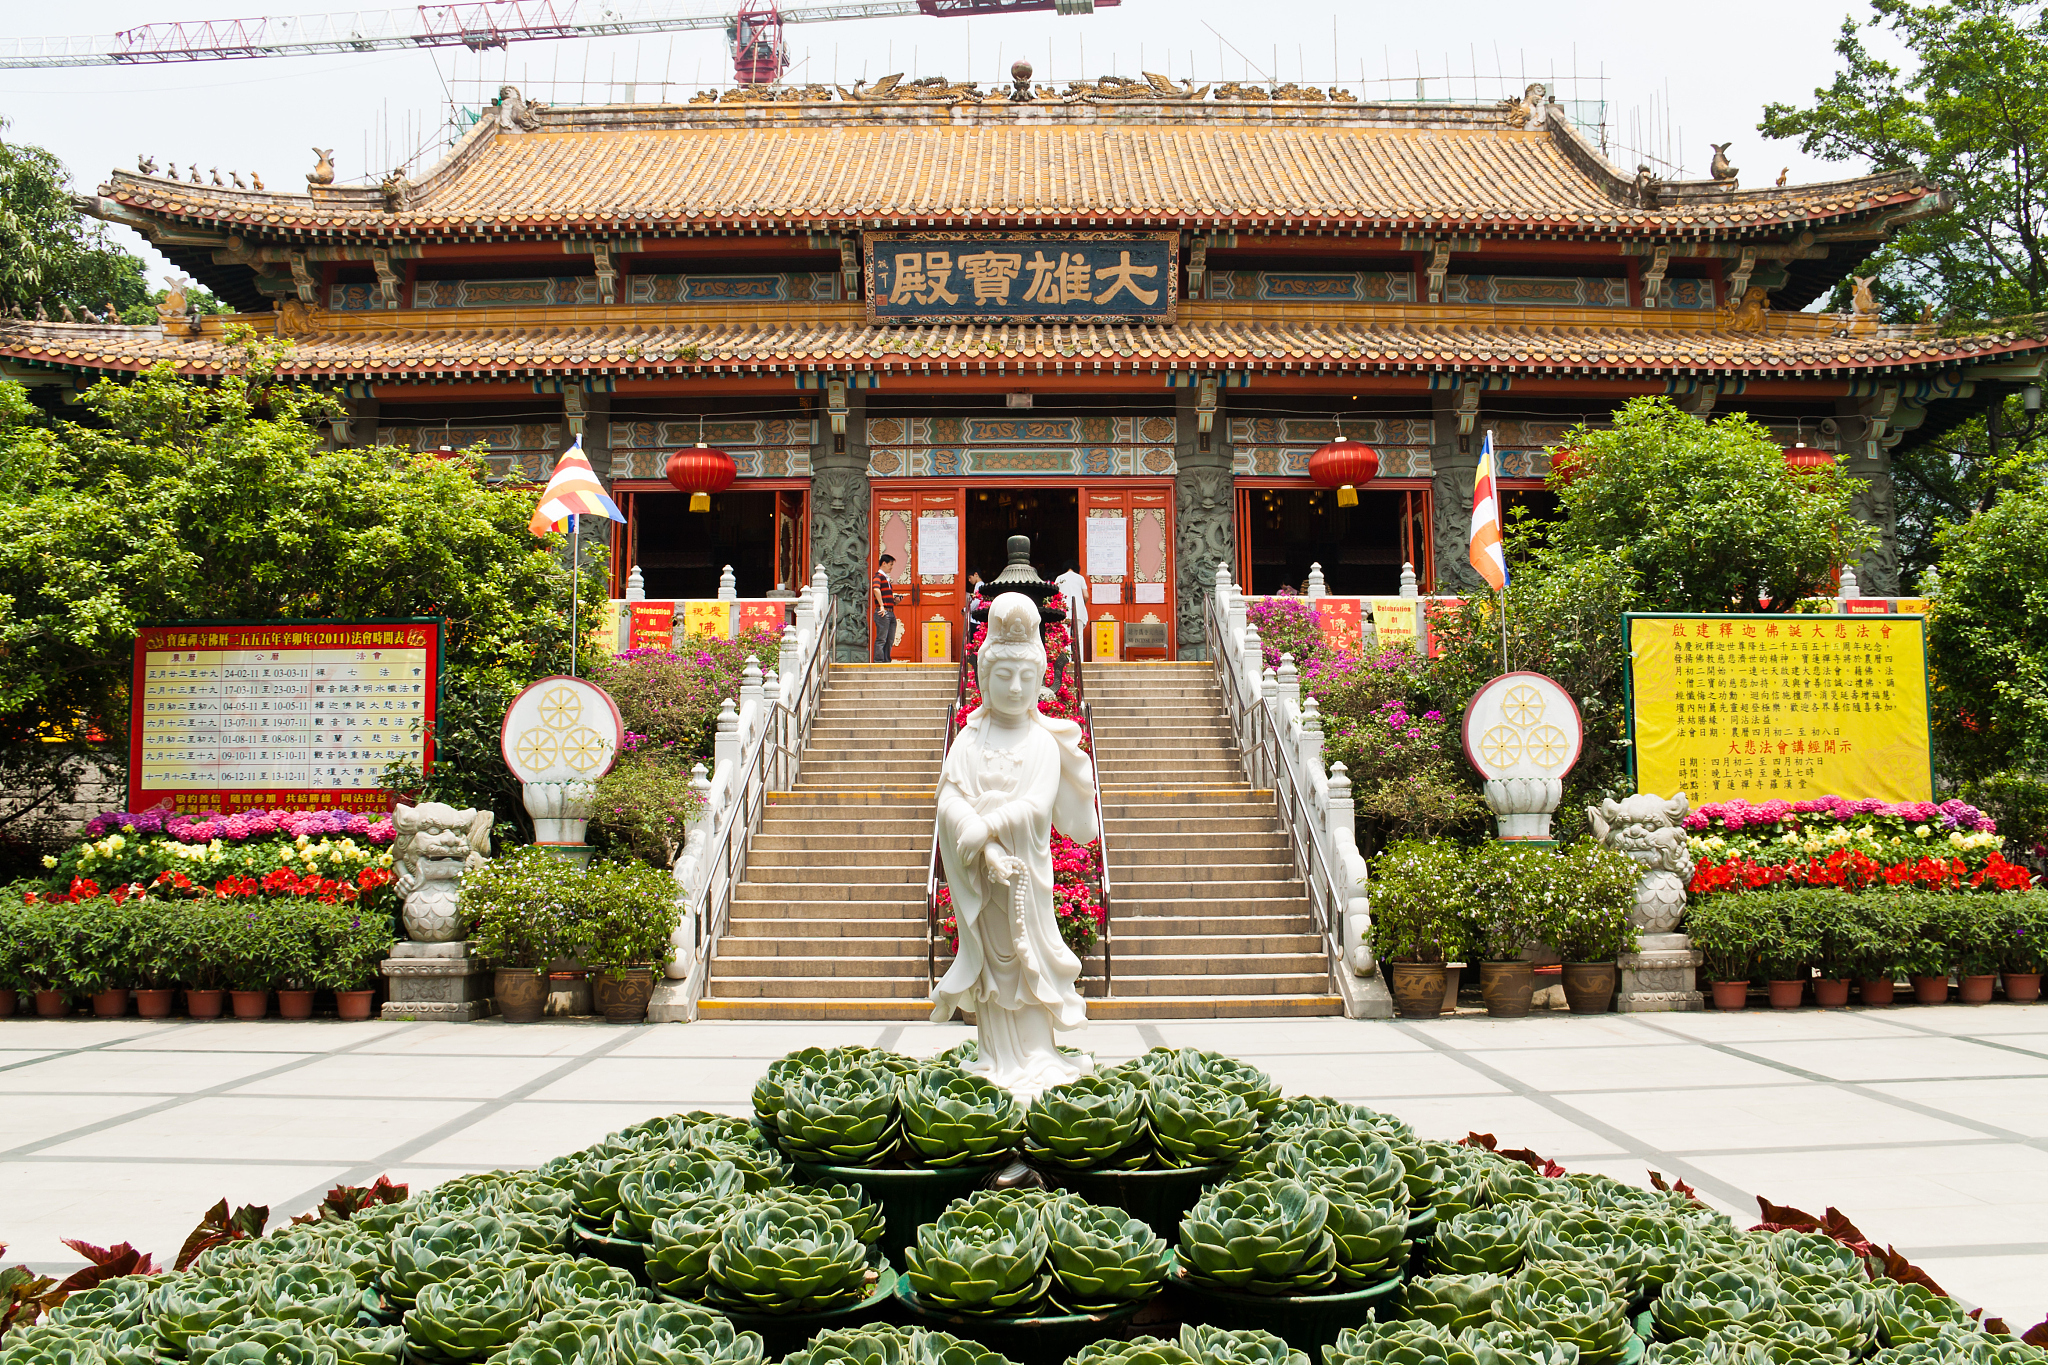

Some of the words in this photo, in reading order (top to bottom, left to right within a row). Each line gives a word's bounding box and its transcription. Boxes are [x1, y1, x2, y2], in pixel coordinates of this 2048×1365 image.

[889, 251, 1158, 306] 大雄寶殿
[636, 607, 671, 615] Celebration
[649, 618, 656, 626] Of
[1672, 622, 1892, 639] 啟建釋迦佛誕大悲法會
[356, 651, 382, 660] 法會
[148, 669, 219, 679] 正月廿二至廿九
[224, 669, 259, 678] 24-02-11
[262, 669, 271, 678] 至
[274, 669, 308, 678] 03-03-11
[147, 685, 218, 695] 二月十三至十九
[224, 686, 258, 694] 17-03-11
[261, 685, 270, 694] 至
[273, 686, 308, 694] 23-03-11
[147, 702, 218, 711] 四月初二至初八
[223, 702, 258, 710] 04-05-11
[261, 702, 270, 710] 至
[273, 702, 307, 711] 10-05-11
[146, 718, 217, 727] 六月十三至十九
[223, 719, 257, 727] 13-07-11
[261, 719, 270, 727] 至
[273, 718, 307, 727] 19-07-11
[1798, 728, 1807, 737] 至
[1811, 727, 1840, 737] 初八日
[146, 735, 216, 744] 七月初二至初九
[222, 735, 257, 743] 01-08-11
[260, 735, 269, 743] 至
[272, 734, 306, 743] 08-08-11
[1728, 739, 1852, 755] 大悲法會講經開示
[146, 751, 216, 760] 九月十三至十九
[221, 752, 256, 760] 09-10-11
[260, 751, 269, 760] 至
[272, 751, 306, 760] 15-10-11
[1758, 757, 1767, 767] 至
[1773, 756, 1823, 767] 四月初六日
[145, 772, 216, 781] 十一月十二至十九
[221, 772, 256, 781] 06-12-11
[259, 772, 269, 781] 至
[272, 772, 306, 780] 13-12-11
[1759, 768, 1768, 778] 至
[356, 804, 388, 812] 5248
